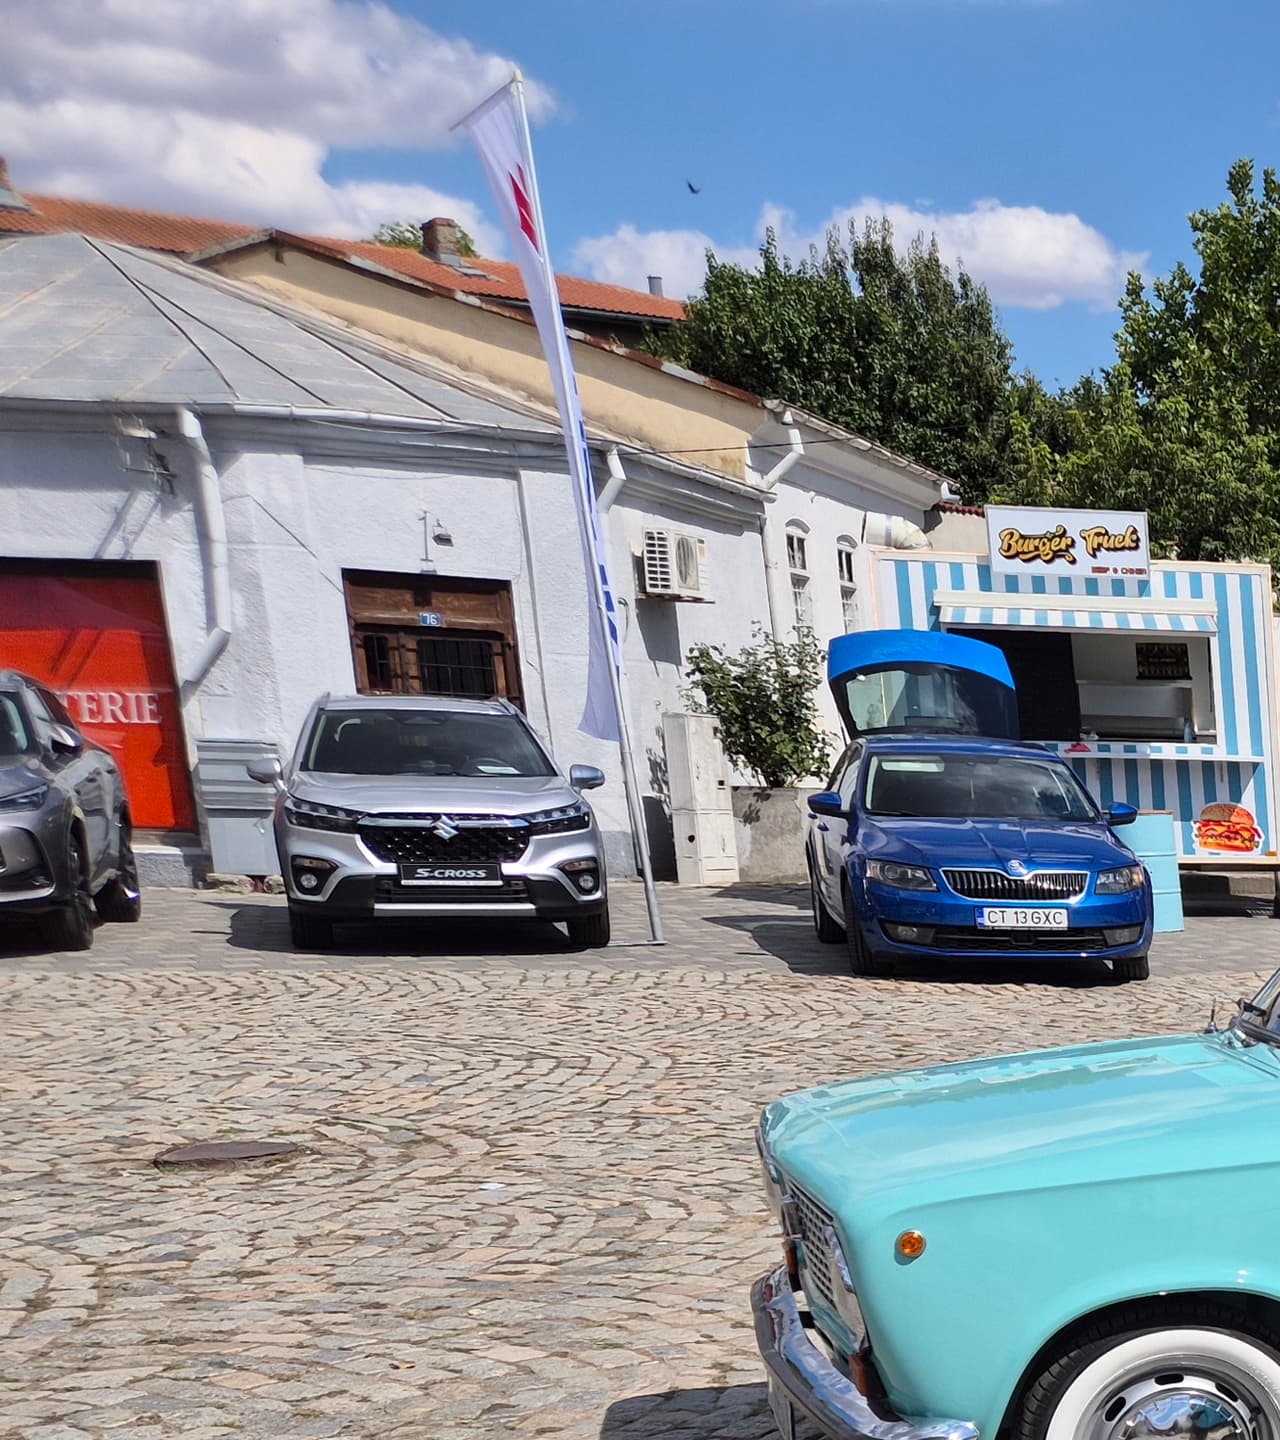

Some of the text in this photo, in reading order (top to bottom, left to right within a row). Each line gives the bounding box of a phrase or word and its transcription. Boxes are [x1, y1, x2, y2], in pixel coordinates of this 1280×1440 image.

[999, 525, 1140, 565] Burger Truck
[422, 613, 437, 625] 76
[414, 868, 488, 878] S-CROSS
[987, 910, 1063, 925] CT 13 GXC
